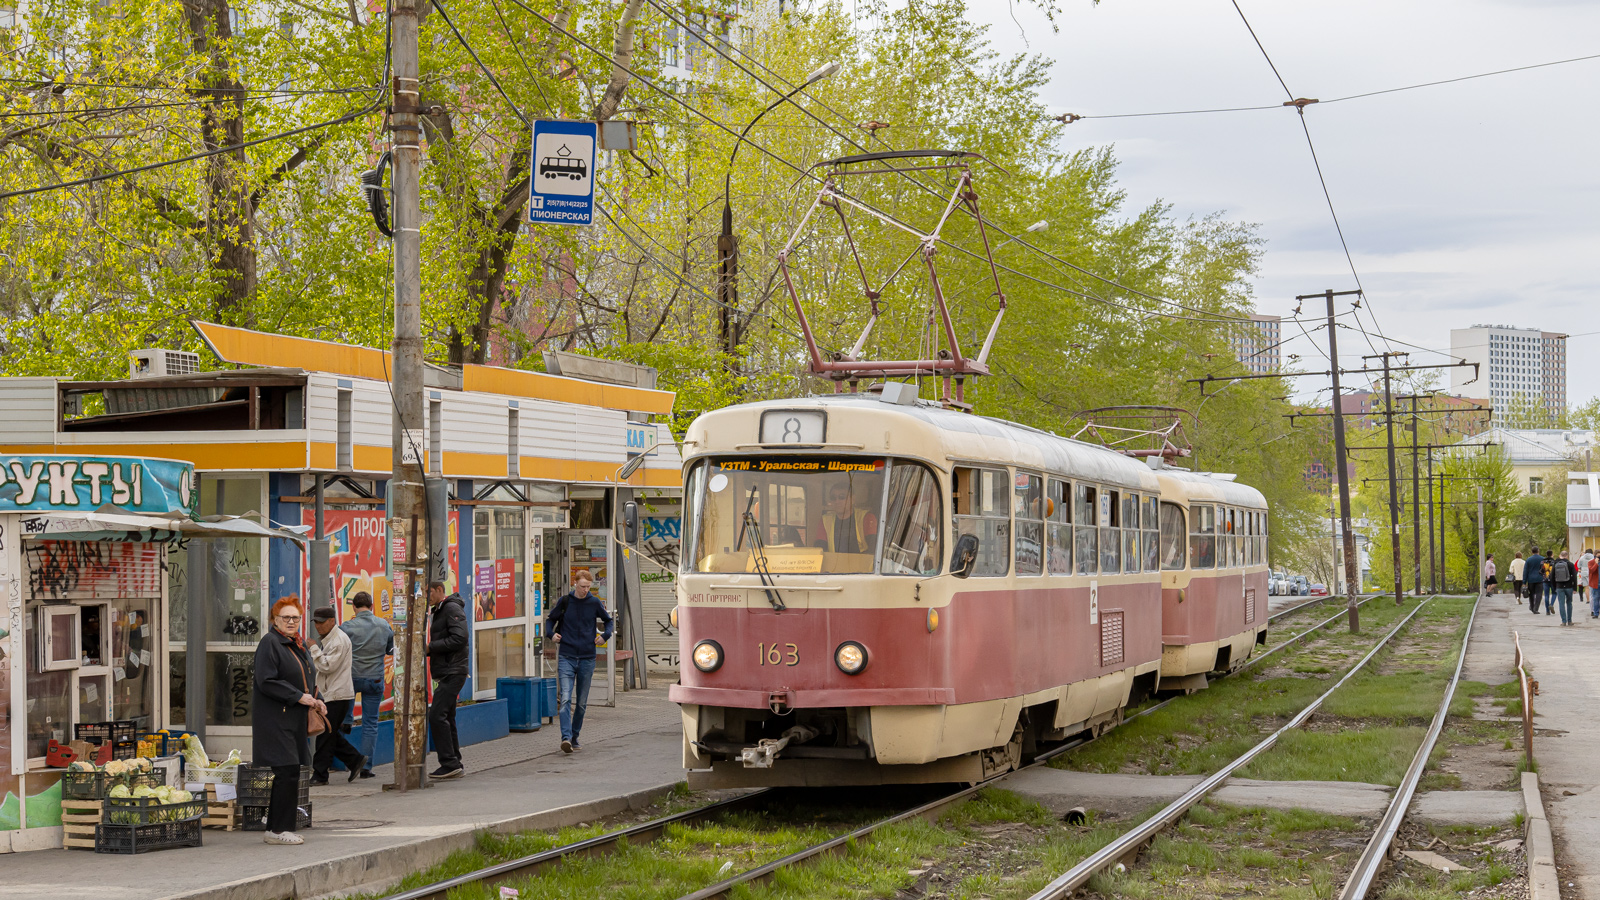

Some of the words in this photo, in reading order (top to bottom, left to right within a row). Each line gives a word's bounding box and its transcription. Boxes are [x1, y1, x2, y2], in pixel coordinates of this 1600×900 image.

[532, 210, 590, 221] ПИОНЕРСКАЯ
[782, 417, 801, 443] 8
[720, 461, 750, 471] УЗТМ
[759, 461, 819, 471] Уральская
[828, 461, 875, 472] Шарташ
[759, 643, 800, 666] 163
